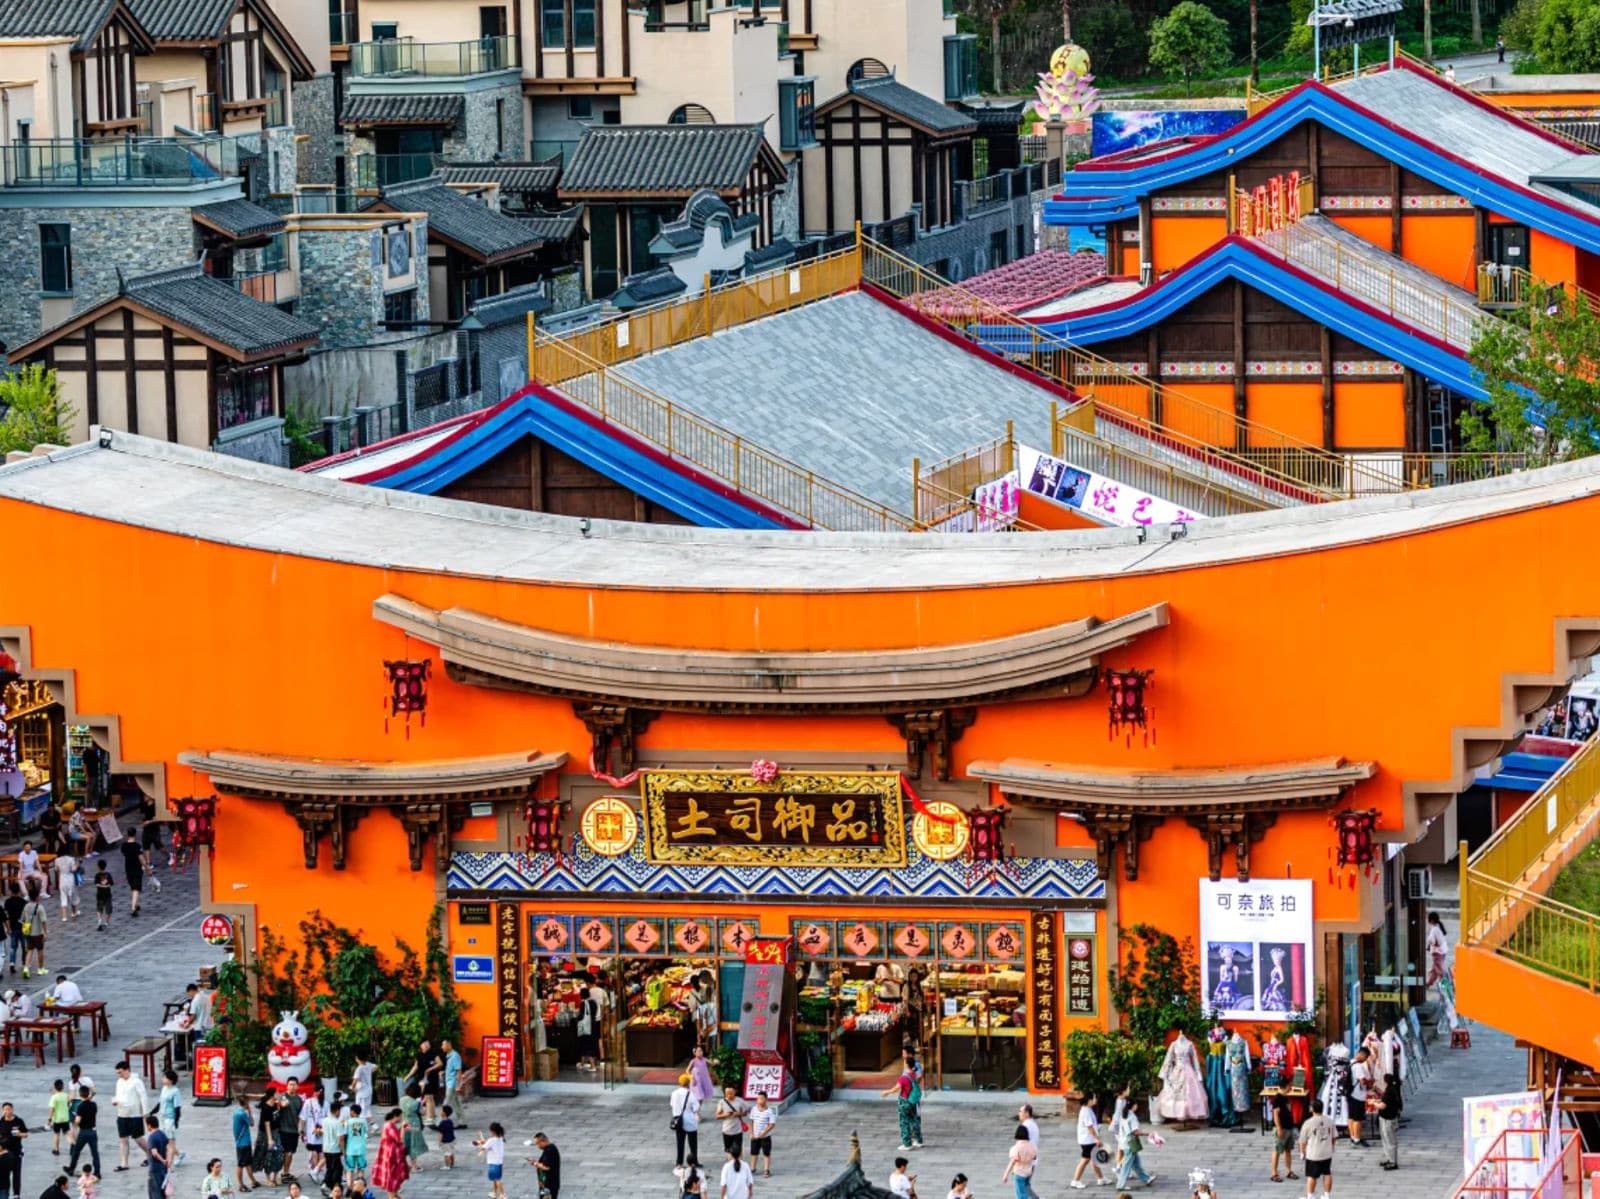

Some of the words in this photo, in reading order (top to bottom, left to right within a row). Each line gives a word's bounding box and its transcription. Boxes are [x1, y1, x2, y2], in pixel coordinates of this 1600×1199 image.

[672, 795, 867, 844] 土司御品
[1217, 893, 1296, 912] 可奈旅拍
[750, 1067, 781, 1080] 心心
